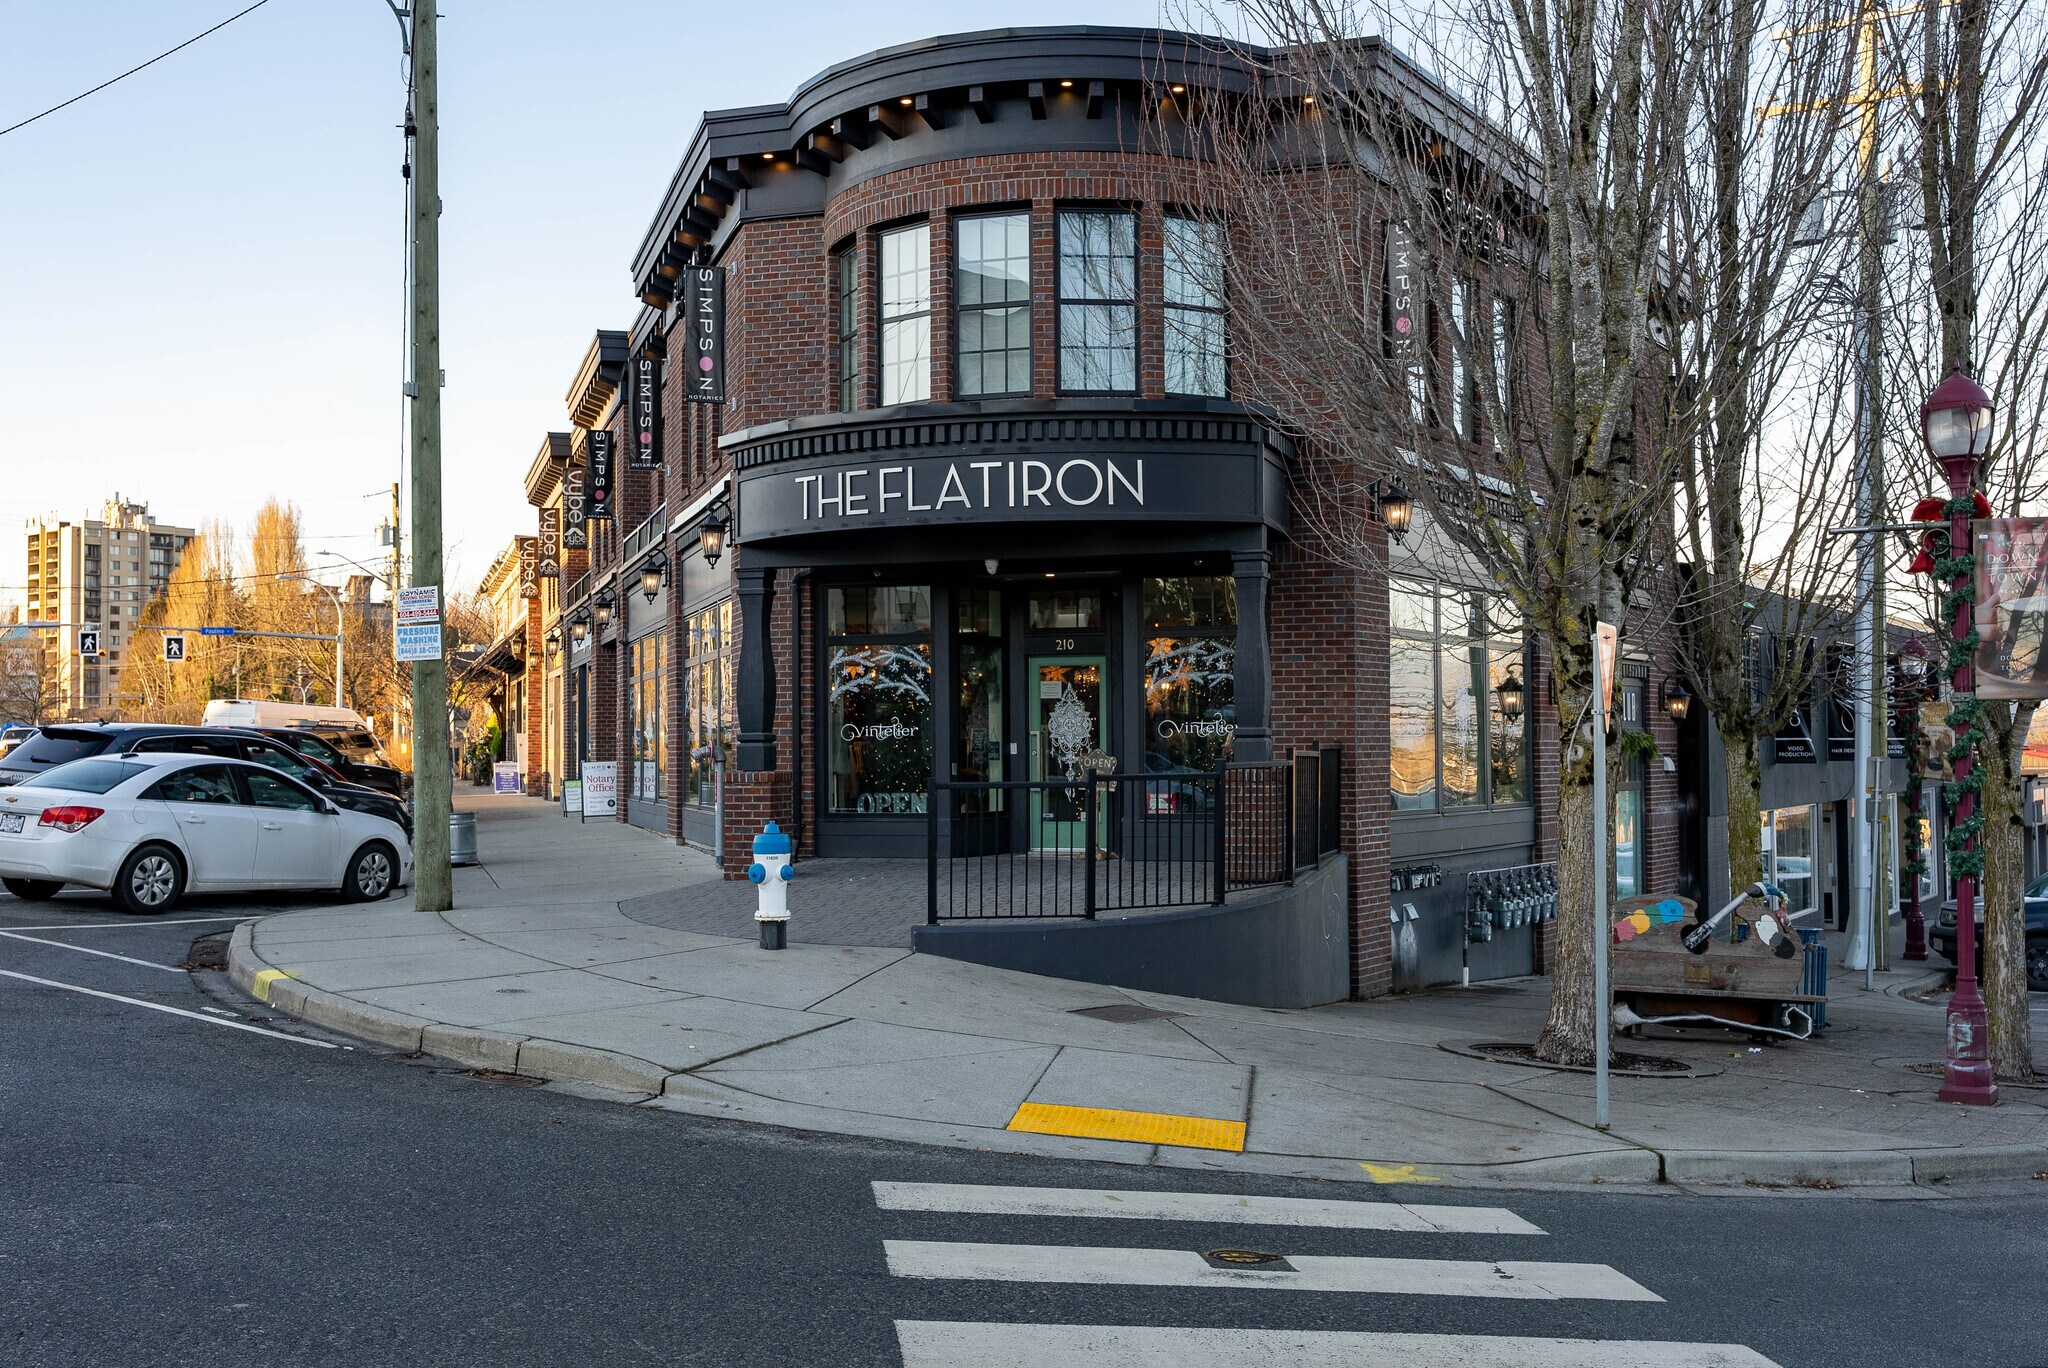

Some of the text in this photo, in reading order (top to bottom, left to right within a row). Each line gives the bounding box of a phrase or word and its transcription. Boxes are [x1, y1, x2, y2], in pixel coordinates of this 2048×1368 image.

[794, 458, 1144, 520] THE FLATIRON
[562, 470, 586, 524] vybe
[540, 510, 560, 556] vybe
[1987, 553, 2037, 564] DOWN
[1987, 572, 2037, 584] TOWN
[397, 626, 439, 636] PRESSURE
[400, 636, 438, 645] WASHING
[1055, 639, 1074, 651] 210
[1084, 758, 1111, 768] OPEN
[586, 775, 616, 785] Notary
[588, 783, 614, 793] Office
[857, 792, 928, 813] OPEN
